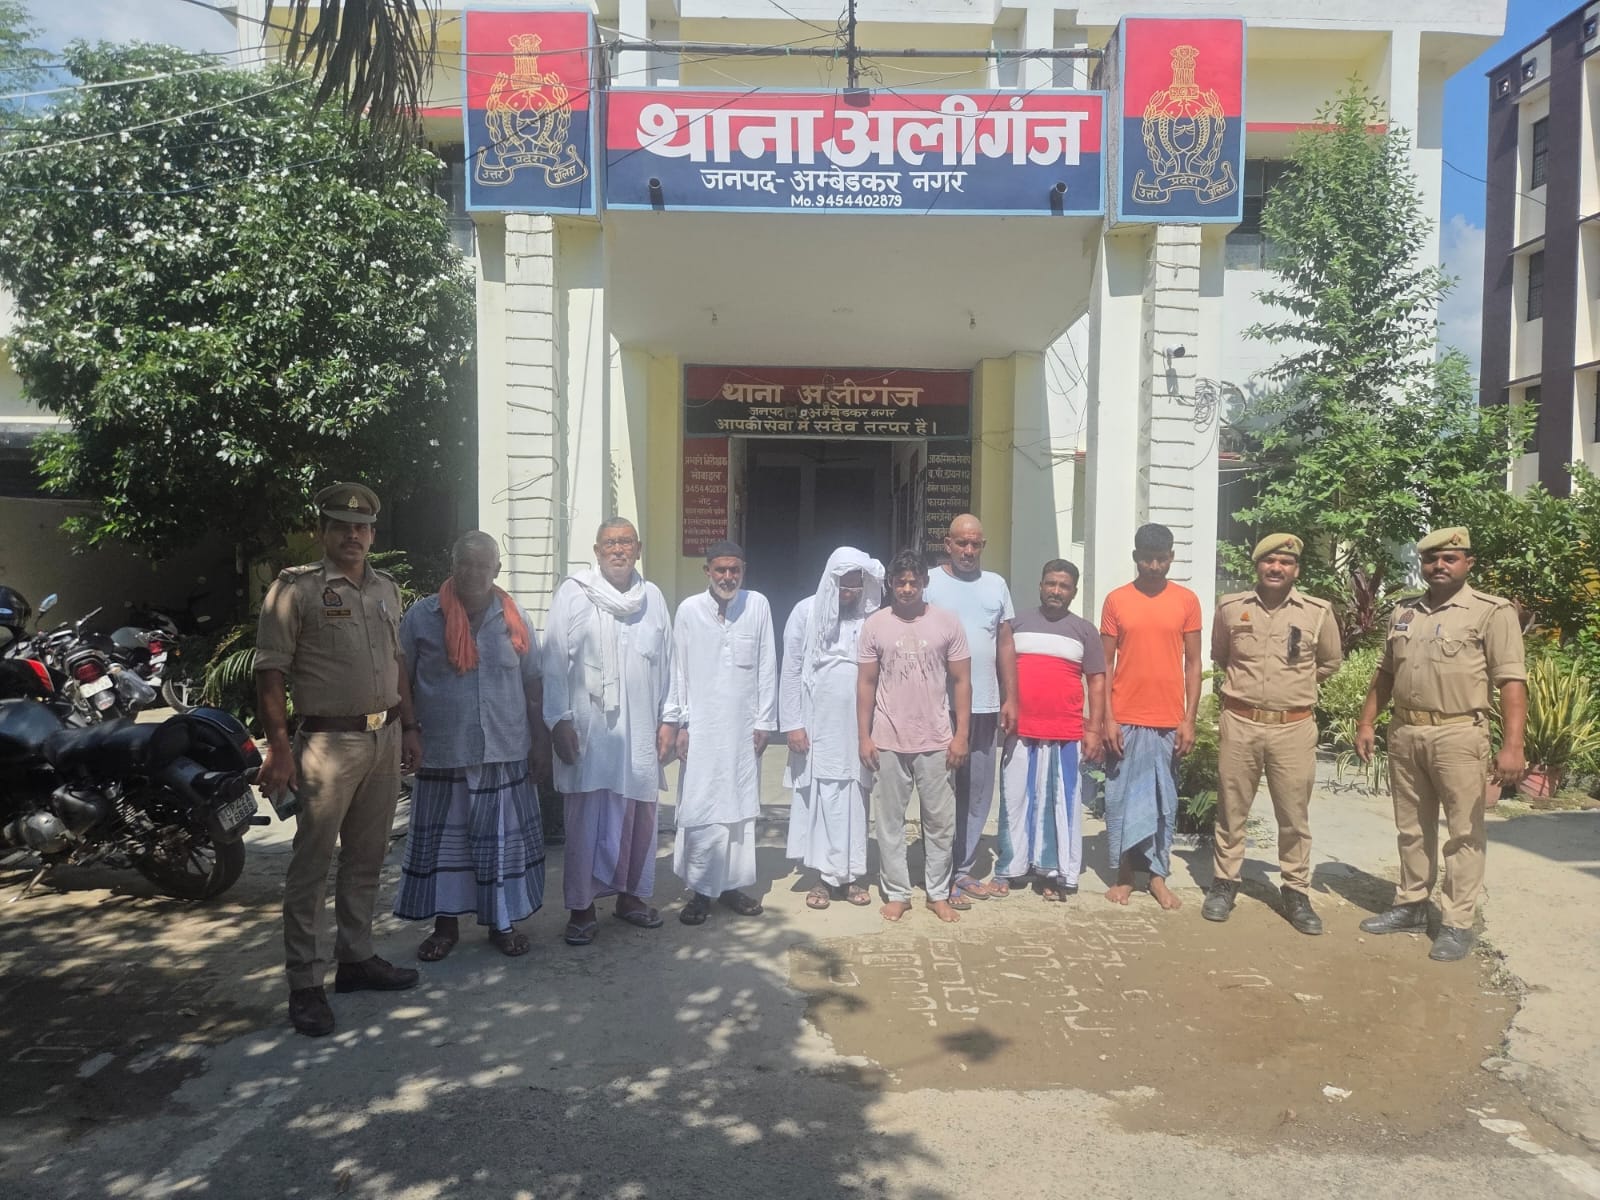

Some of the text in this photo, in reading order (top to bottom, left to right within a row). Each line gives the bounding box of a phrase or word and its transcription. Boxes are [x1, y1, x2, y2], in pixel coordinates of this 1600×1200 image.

[636, 95, 1089, 168] थाना अलीगंज
[513, 155, 547, 165] प्रदेश
[482, 168, 505, 180] उत्तर
[553, 164, 576, 182] पुलिस
[790, 165, 902, 195] अम्बेडकर
[912, 171, 968, 193] नगर
[1166, 176, 1200, 187] प्रदेश
[1139, 187, 1160, 201] उत्तर
[1207, 182, 1229, 199] पुलिस
[721, 378, 924, 407] थाना अलीगंज
[871, 409, 897, 418] नगर
[763, 417, 794, 433] सेवा
[797, 416, 809, 432] में
